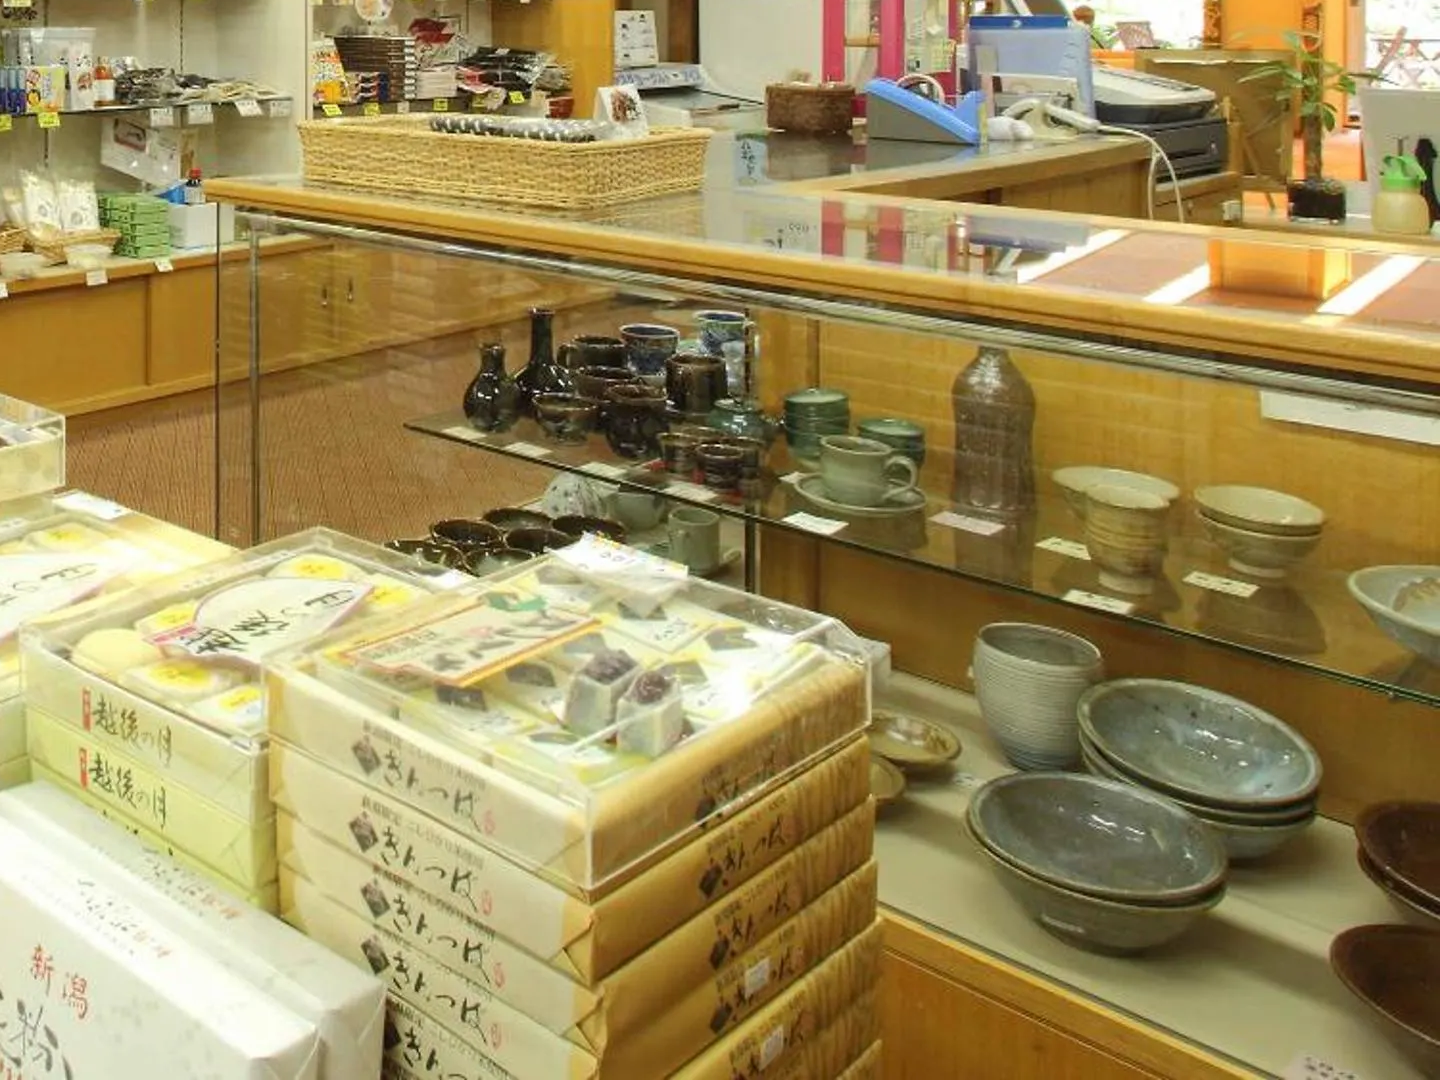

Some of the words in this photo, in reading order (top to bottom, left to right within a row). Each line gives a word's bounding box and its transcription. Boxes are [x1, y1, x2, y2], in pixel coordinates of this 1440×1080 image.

[91, 694, 172, 768] 越後の月
[88, 751, 166, 830] 越後の月
[383, 749, 482, 834] きんつば
[381, 826, 478, 914] きんつば
[392, 893, 490, 984] きんつば
[30, 943, 89, 1020] 新潟
[392, 951, 488, 1044] きんつば
